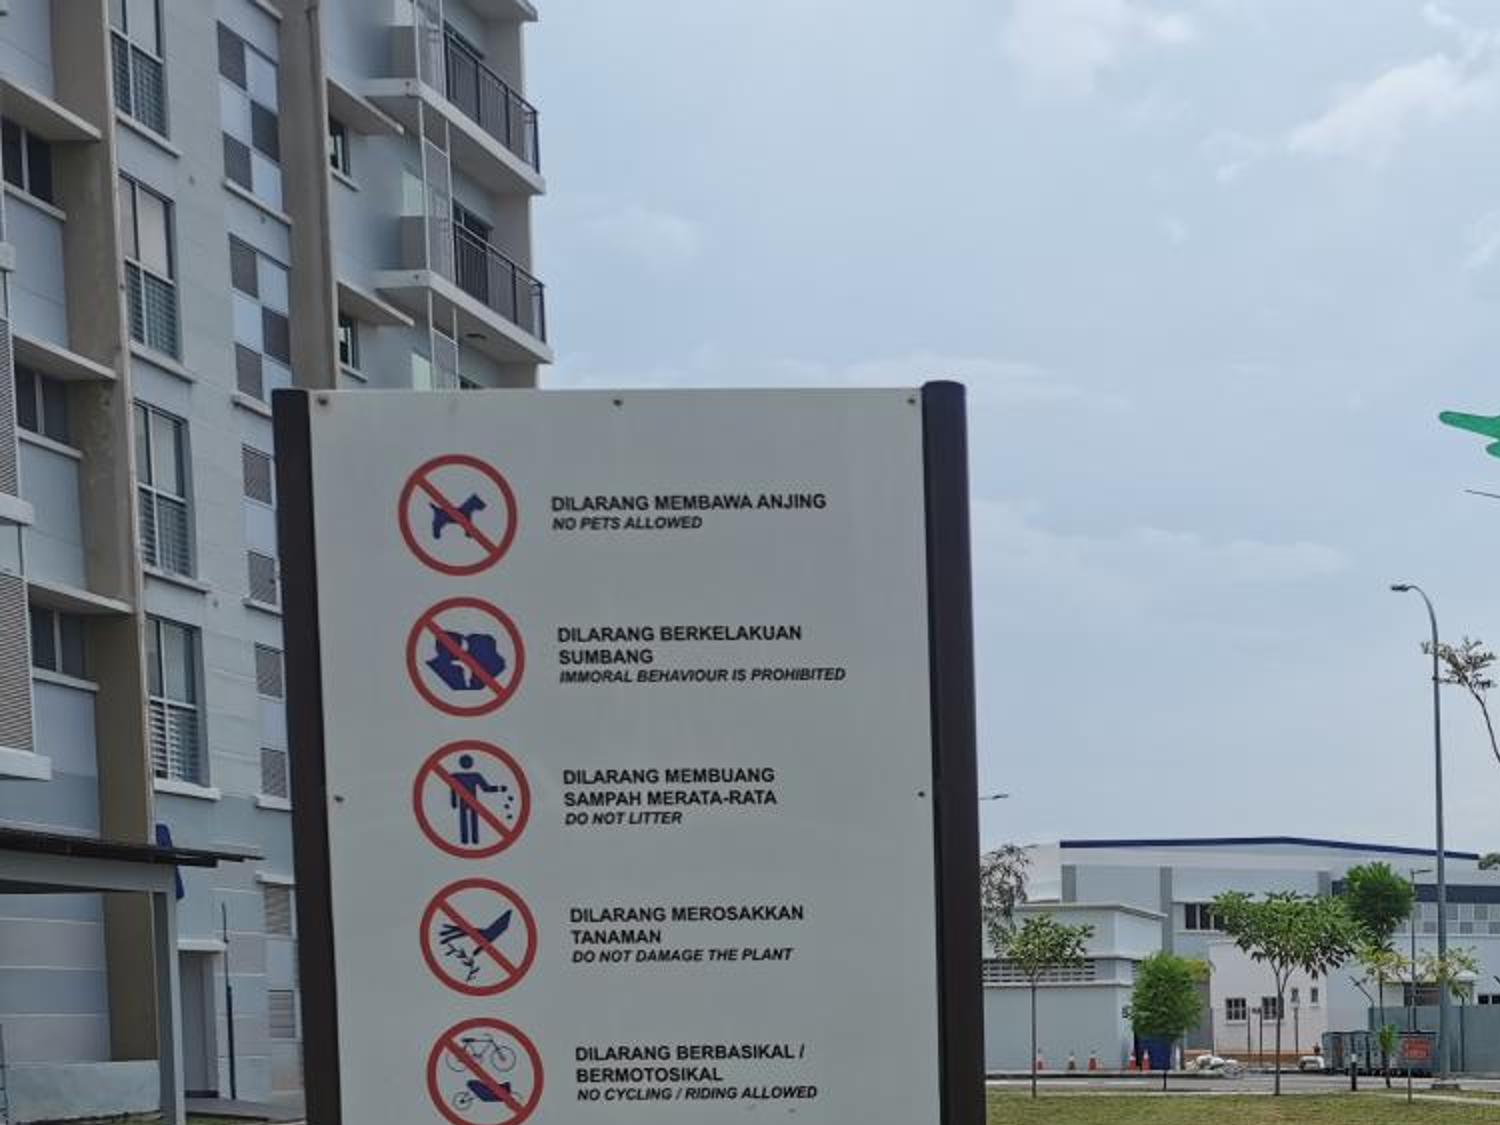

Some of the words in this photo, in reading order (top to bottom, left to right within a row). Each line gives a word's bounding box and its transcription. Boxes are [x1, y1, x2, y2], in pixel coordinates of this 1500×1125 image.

[551, 496, 650, 512] DILARANG
[654, 494, 753, 510] MEMBAWA
[755, 493, 826, 509] ANJING
[552, 517, 577, 530] NO
[579, 517, 621, 530] PETS
[623, 516, 702, 530] ALLOWED
[558, 626, 655, 643] DILARANG
[660, 625, 802, 641] BERKELAKUAN
[559, 649, 653, 665] SUMBANG
[560, 670, 634, 683] IMMORAL
[636, 669, 729, 682] BEHAVIOUR
[730, 669, 747, 682] IS
[750, 667, 846, 681] PROHIBITED
[563, 769, 659, 785] DILARANG
[664, 768, 775, 784] MEMBUANG
[564, 792, 641, 807] SAMPAH
[648, 790, 777, 806] MERATA-RATA
[565, 812, 589, 826] DO
[591, 812, 625, 825] NOT
[627, 811, 682, 824] LITTER
[570, 907, 666, 923] DILARANG
[671, 905, 804, 921] MEROSAKKAN
[571, 929, 661, 944] TANAMAN
[572, 950, 596, 963] DO
[598, 950, 632, 963] NOT
[635, 949, 703, 962] DAMAGE
[706, 948, 738, 961] THE
[740, 948, 794, 961] PLANT
[576, 1045, 671, 1061] DILARANG
[676, 1044, 795, 1060] BERBASIKAL
[576, 1067, 724, 1083] BERMOTOSIKAL
[577, 1088, 601, 1101] NO
[603, 1088, 673, 1101] CYCLING
[684, 1086, 738, 1100] RIDING
[740, 1086, 818, 1100] ALLOWED
